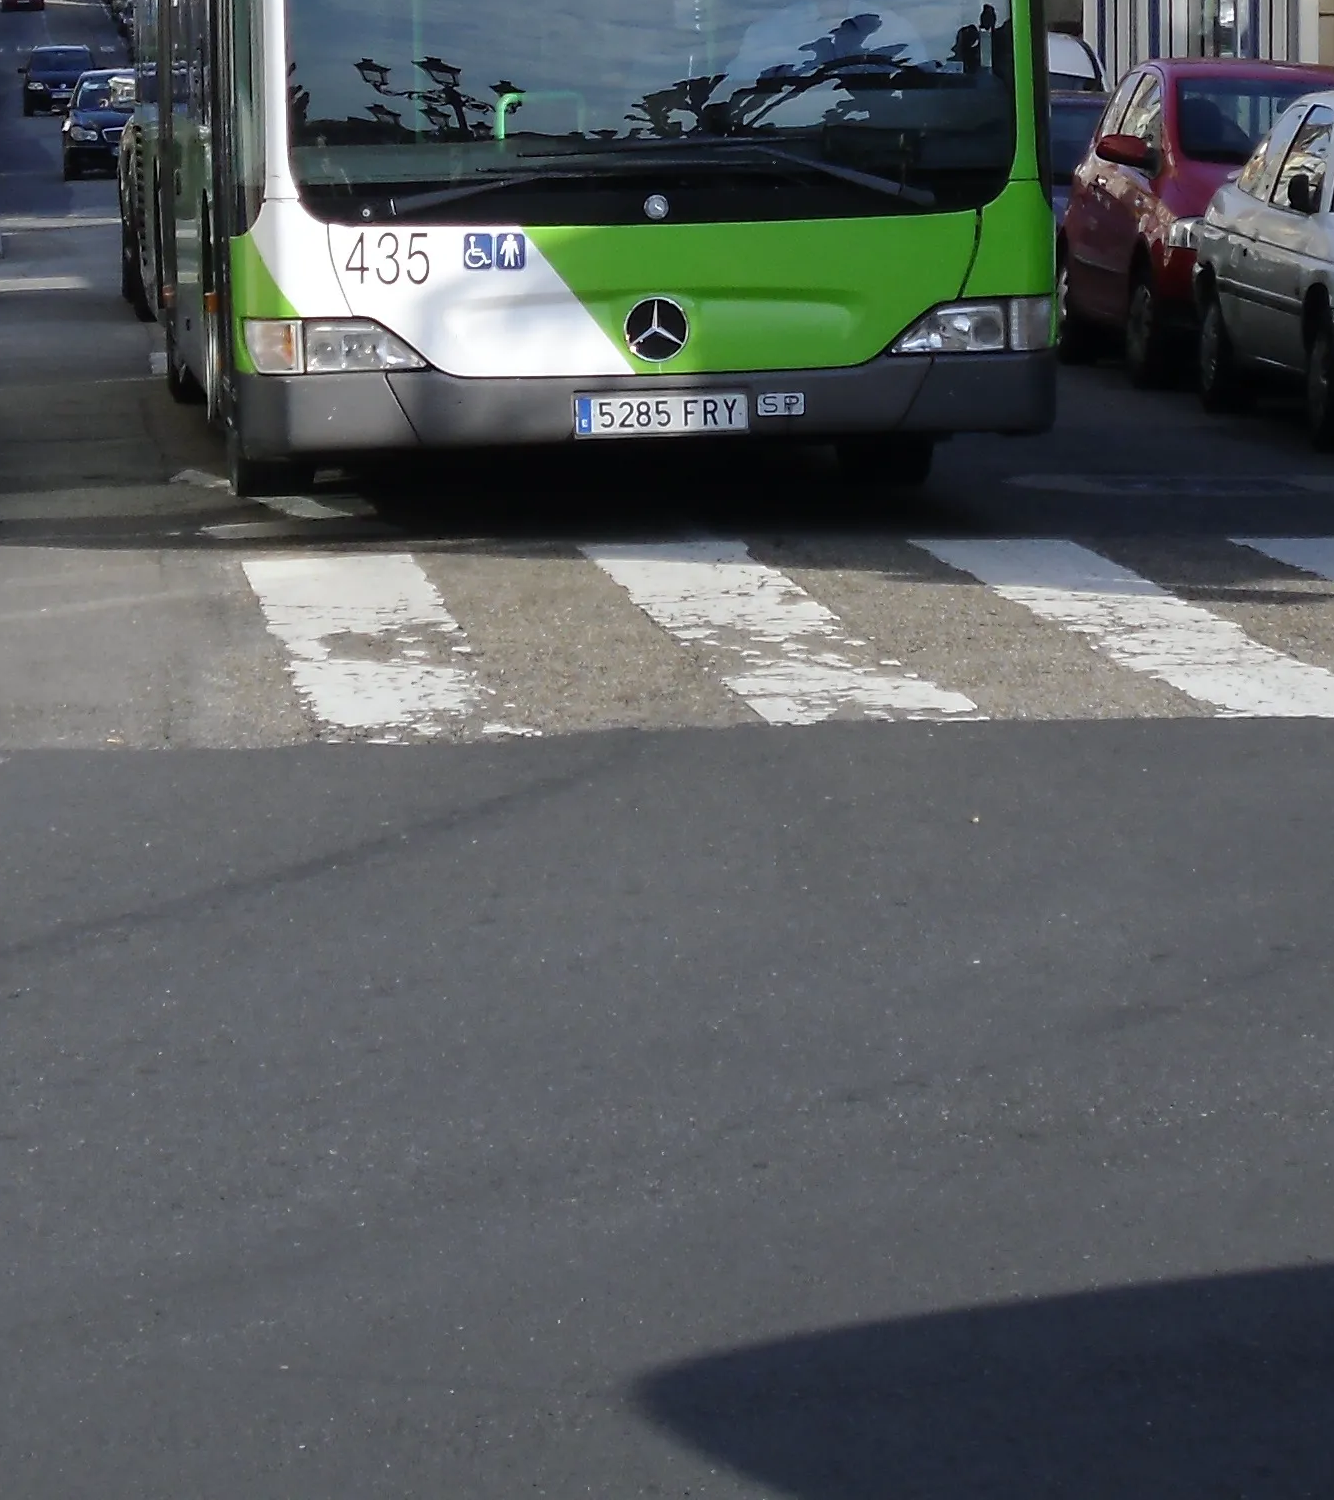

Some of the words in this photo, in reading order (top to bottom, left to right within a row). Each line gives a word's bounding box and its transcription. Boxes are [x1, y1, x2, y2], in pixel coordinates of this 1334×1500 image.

[345, 231, 430, 285] 435
[598, 400, 672, 428] 5285
[683, 398, 738, 427] FRY
